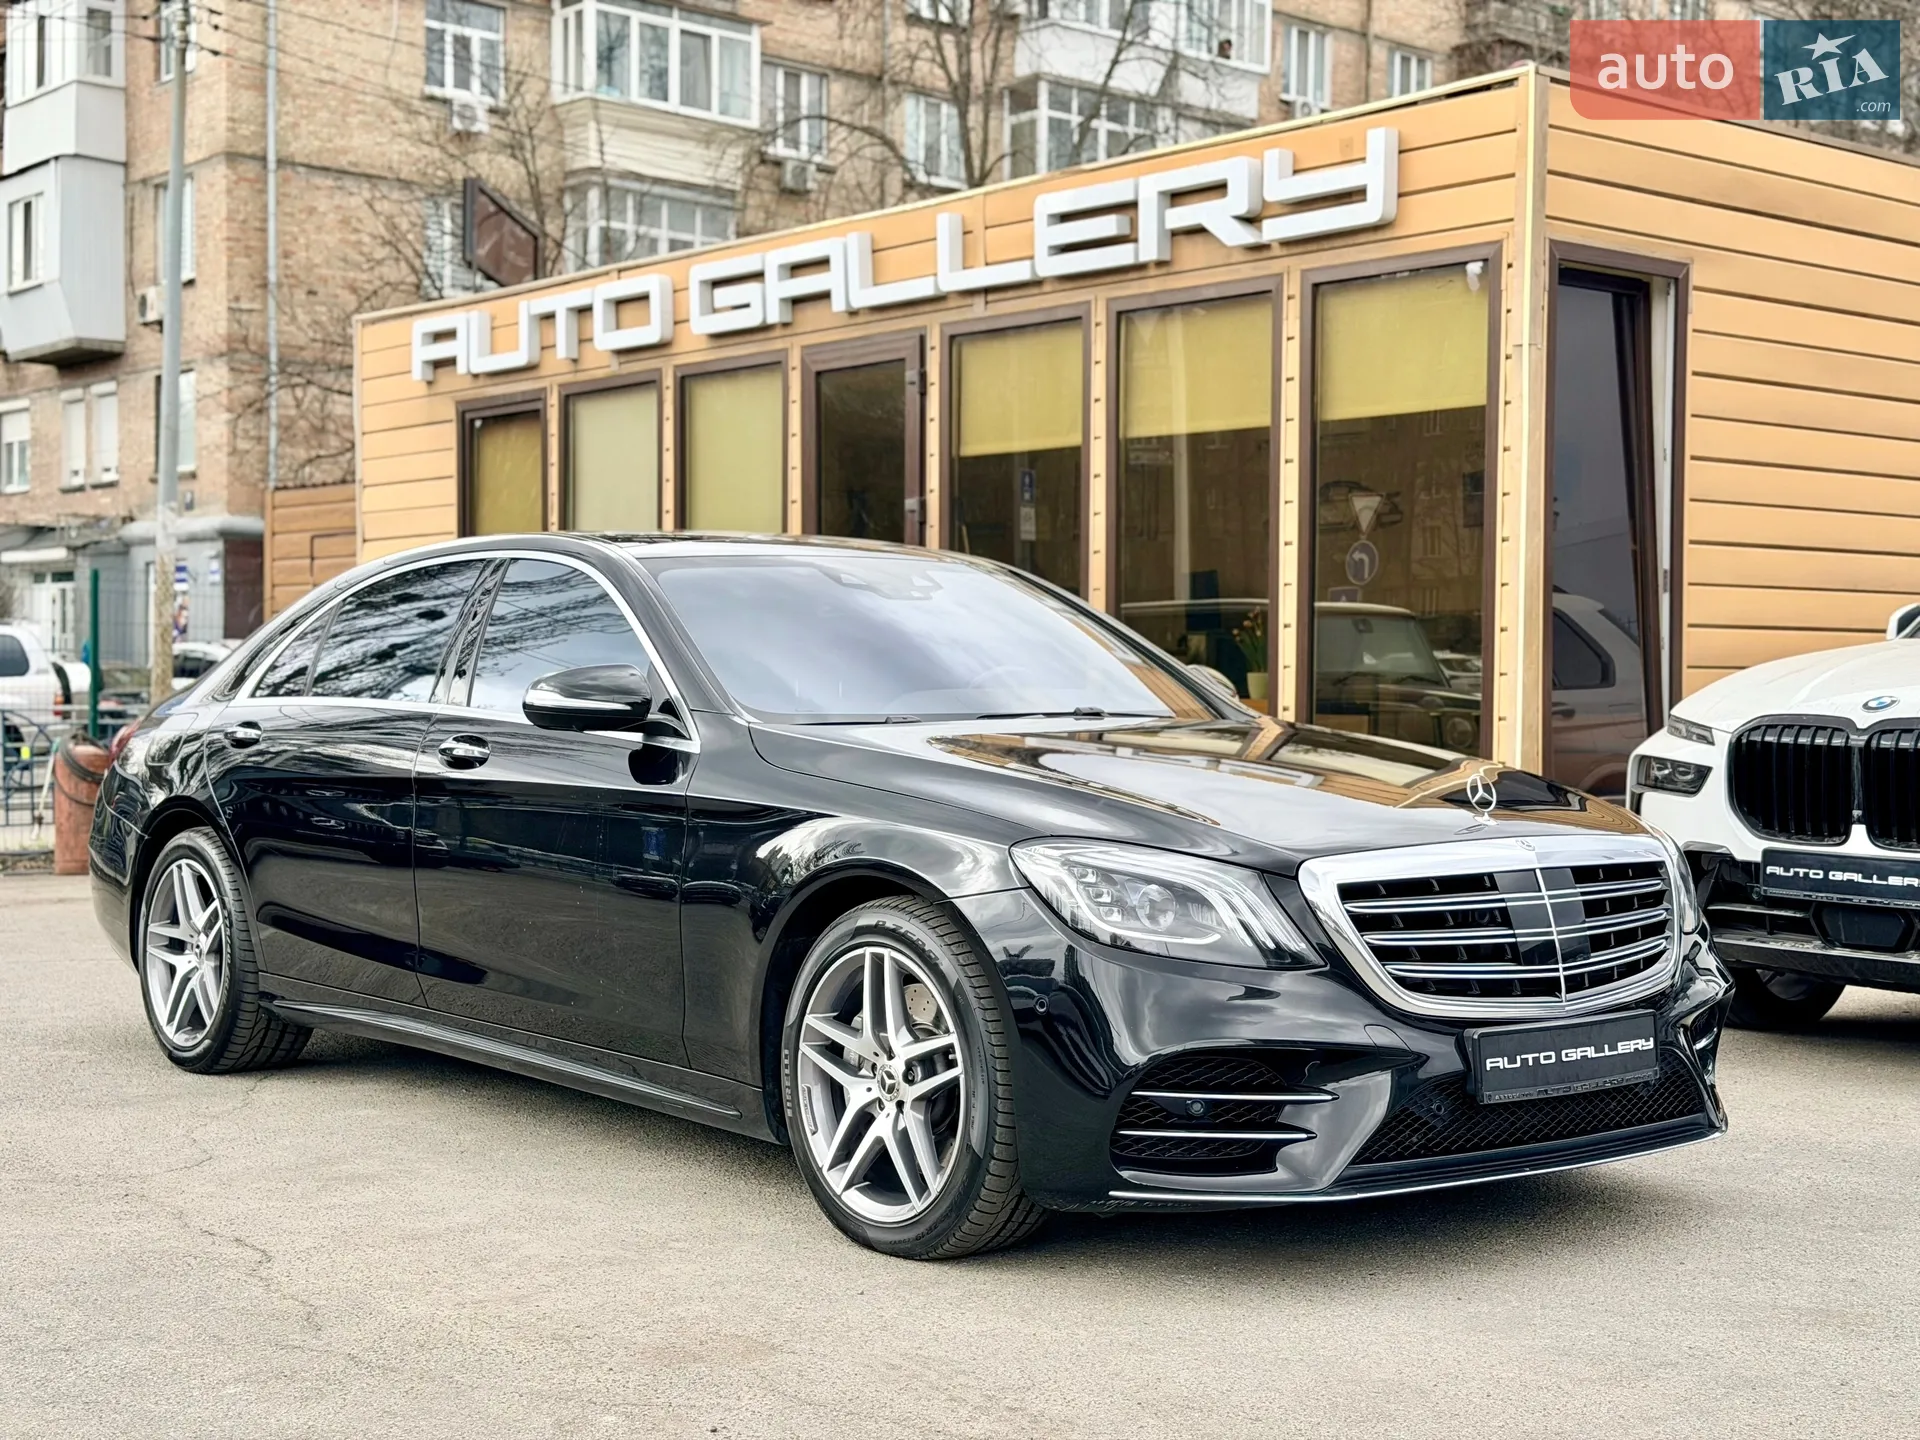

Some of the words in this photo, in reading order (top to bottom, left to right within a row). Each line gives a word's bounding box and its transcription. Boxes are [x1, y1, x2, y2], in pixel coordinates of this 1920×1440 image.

[411, 273, 674, 382] AUTO
[688, 127, 1399, 336] GALLERY
[1766, 866, 1824, 879] AUTO
[1828, 871, 1920, 888] GALLER
[1486, 1051, 1556, 1071] AUTO
[1561, 1037, 1655, 1063] GALLERY
